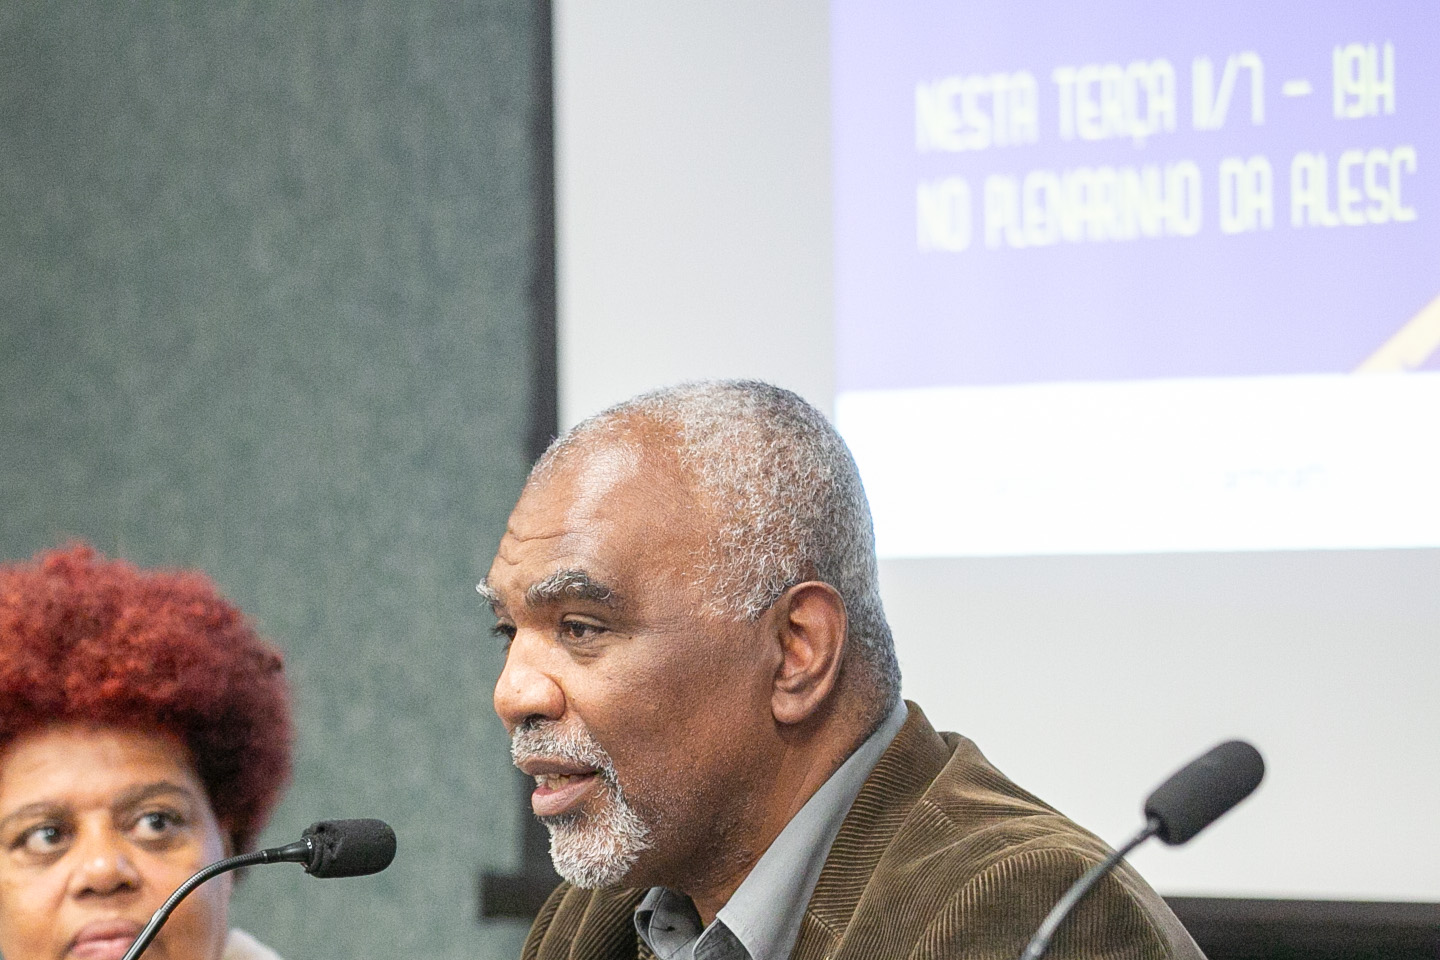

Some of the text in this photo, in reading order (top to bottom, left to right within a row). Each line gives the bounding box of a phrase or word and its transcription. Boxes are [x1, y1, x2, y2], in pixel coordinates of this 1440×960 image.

[915, 73, 1040, 153] NESTA
[1054, 59, 1178, 147] TERÇA
[1333, 40, 1397, 119] 19H
[916, 145, 1420, 253] NO PLENARINHO DA ALESC
